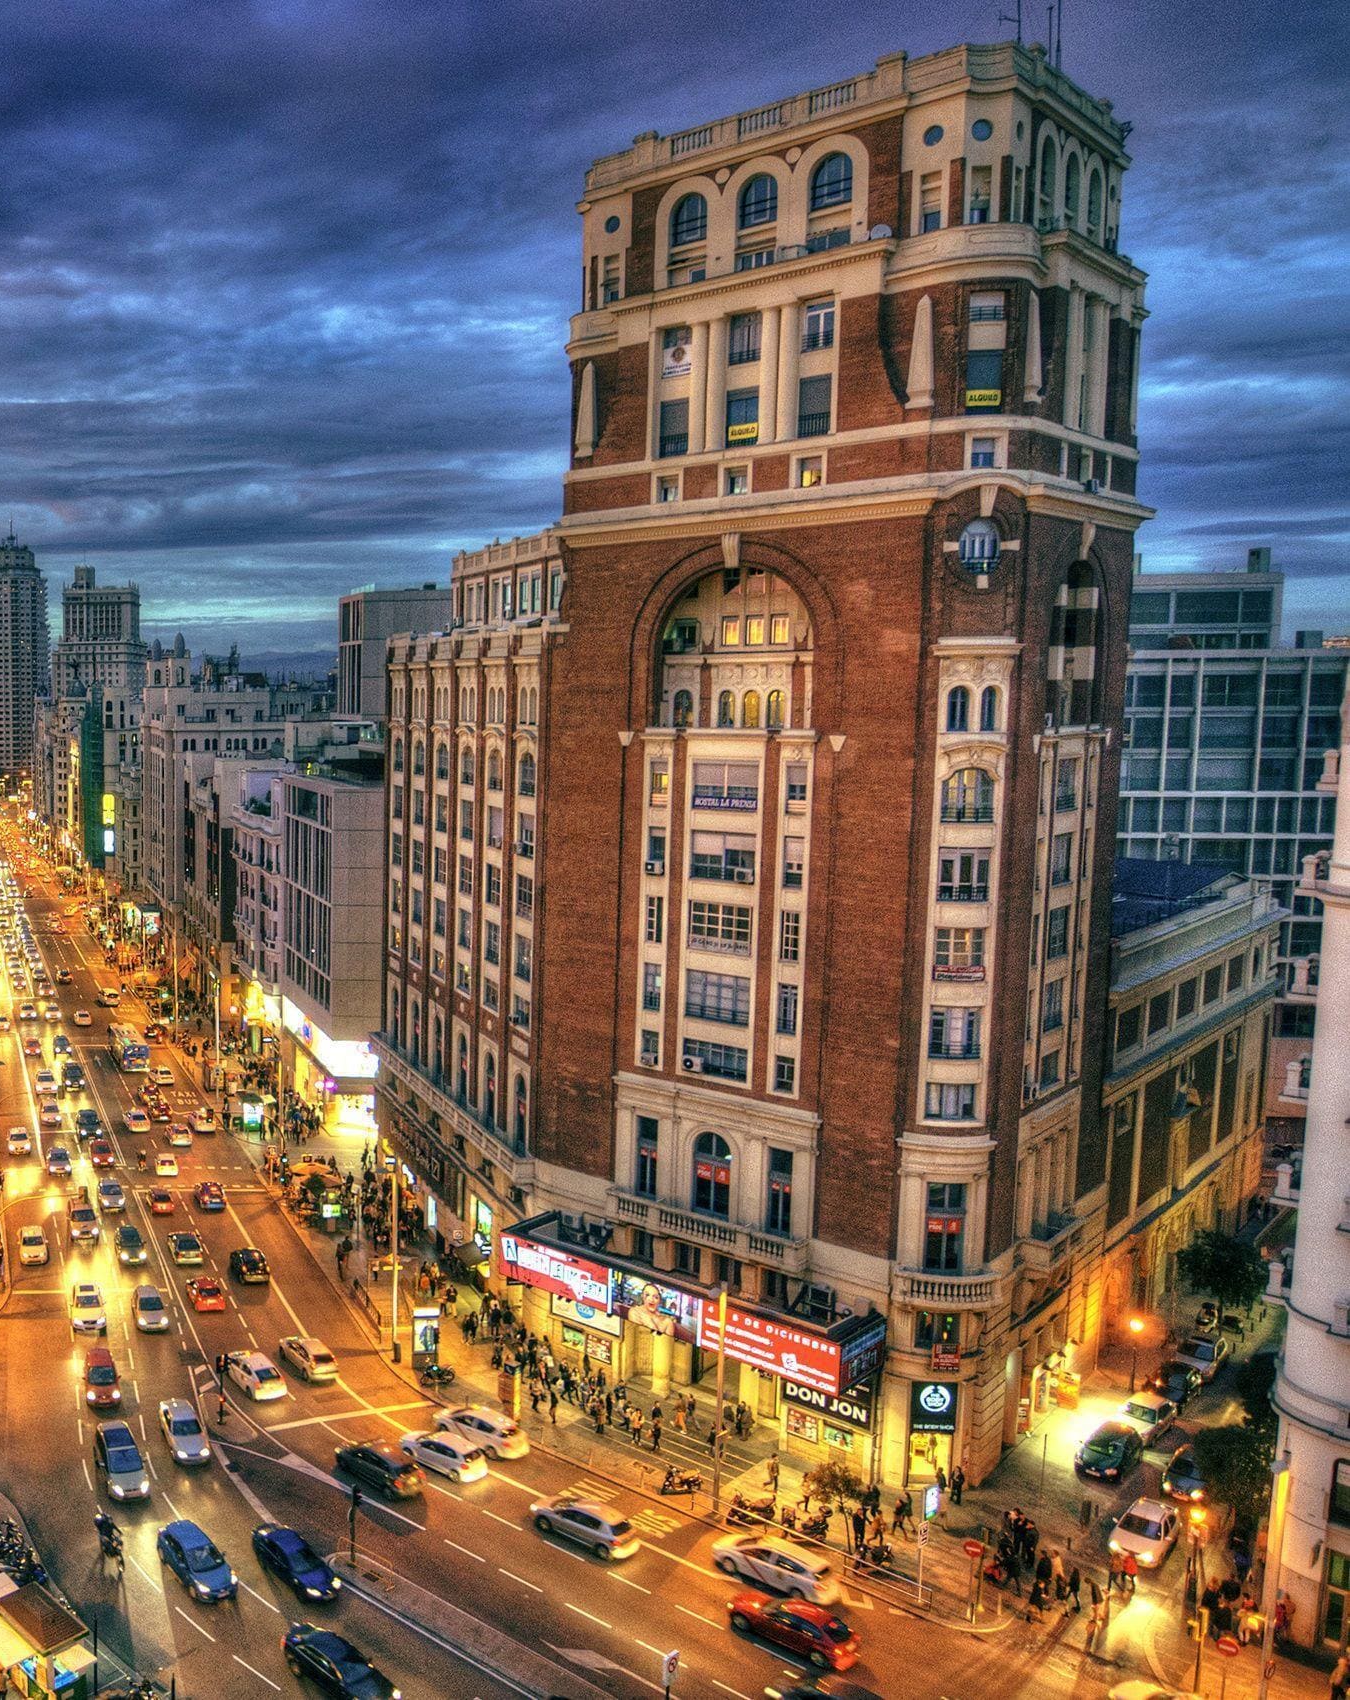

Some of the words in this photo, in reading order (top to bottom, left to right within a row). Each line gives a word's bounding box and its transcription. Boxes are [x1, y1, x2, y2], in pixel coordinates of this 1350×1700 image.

[765, 1324, 837, 1356] DICIEMBRE
[786, 1382, 826, 1408] DON
[829, 1399, 867, 1423] JON
